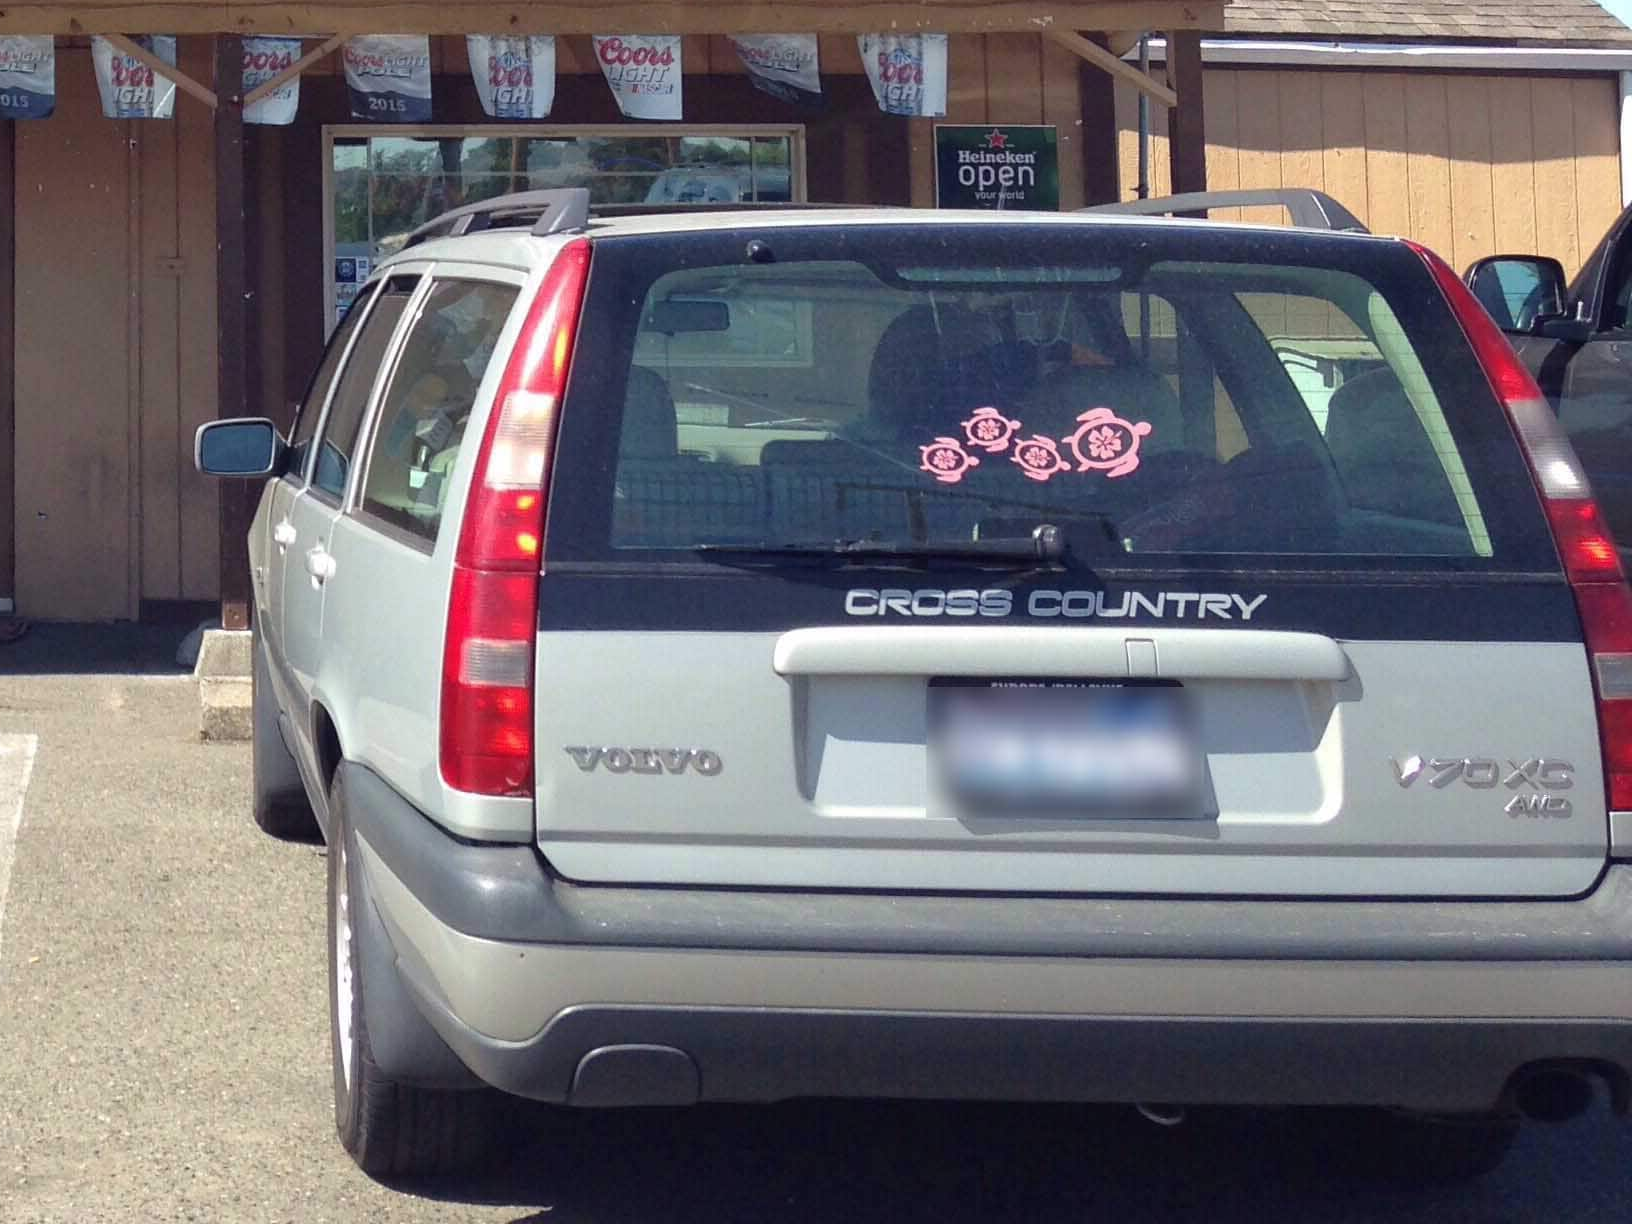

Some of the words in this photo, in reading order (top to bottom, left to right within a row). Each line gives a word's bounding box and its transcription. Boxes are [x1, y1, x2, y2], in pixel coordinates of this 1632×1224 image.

[241, 51, 292, 72] oors
[600, 38, 674, 66] Coors
[369, 98, 407, 112] 2015
[958, 150, 1035, 164] Heineken
[958, 165, 1035, 191] open
[974, 191, 997, 200] your
[997, 190, 1025, 199] world
[845, 589, 1013, 617] CROSS
[1028, 589, 1268, 620] COUNTRY
[562, 745, 723, 776] VOLVO
[1503, 793, 1573, 818] AWD
